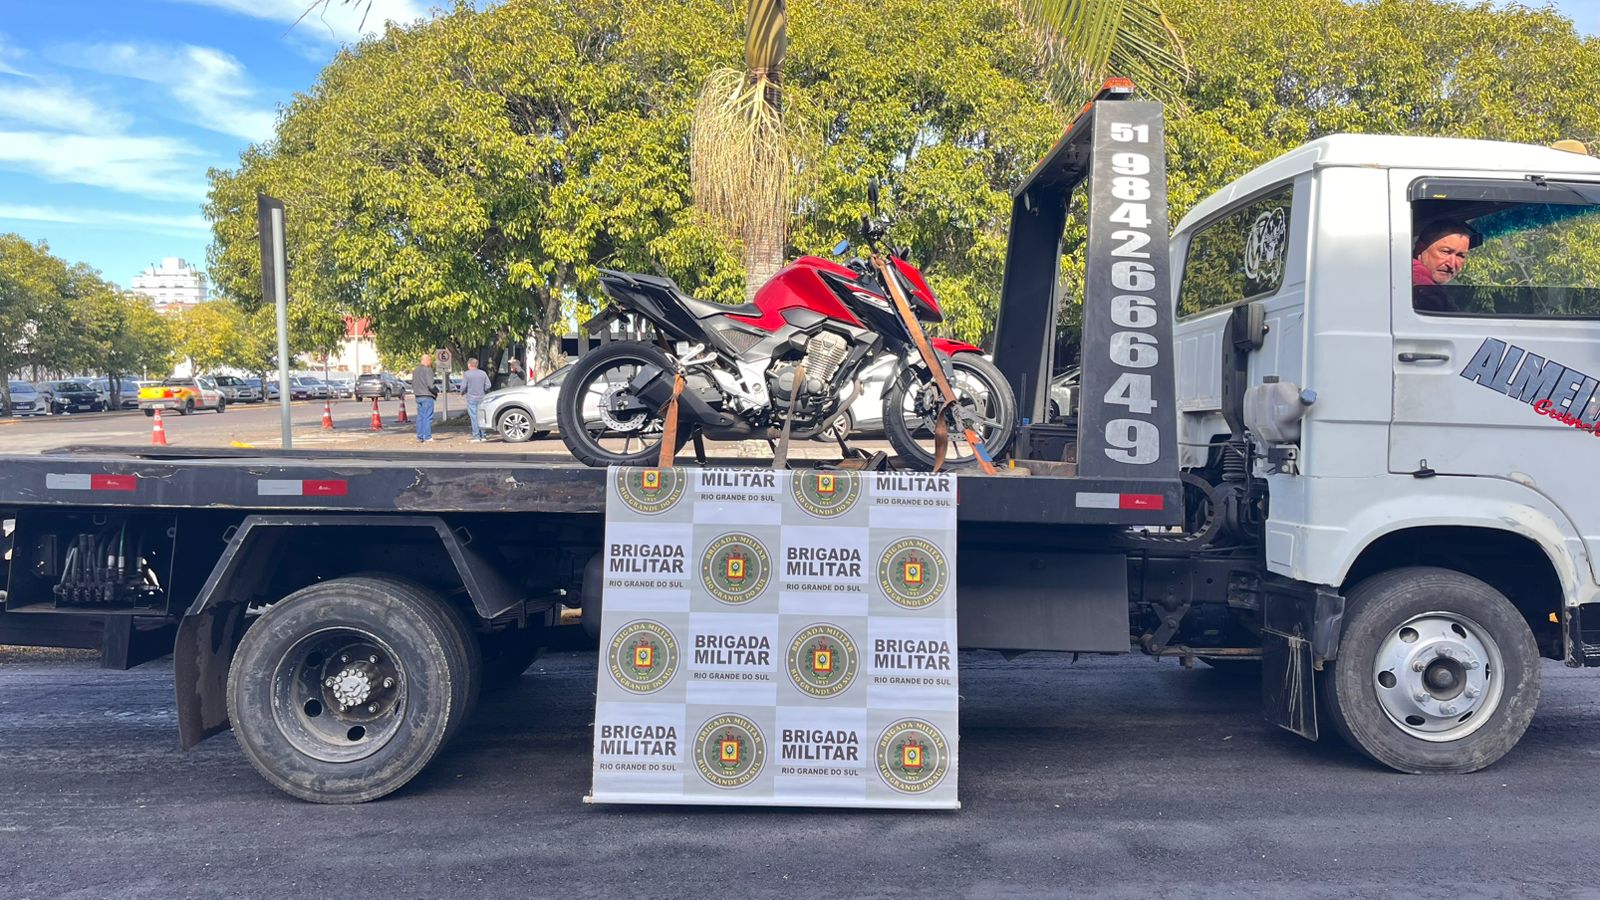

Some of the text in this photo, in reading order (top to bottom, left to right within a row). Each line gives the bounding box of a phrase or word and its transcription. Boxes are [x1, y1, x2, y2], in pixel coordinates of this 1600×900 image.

[1110, 122, 1149, 143] 51
[702, 473, 775, 487] MILITAR
[877, 477, 950, 492] MILITAR
[611, 544, 684, 558] BRIGADA
[706, 536, 766, 560] BRIGADA MILITAR
[788, 547, 862, 561] BRIGADA
[882, 540, 944, 566] BRIGADA MILITAR
[610, 558, 684, 573] MILITAR
[786, 562, 861, 577] MILITAR
[613, 624, 674, 648] BRIGADA MILITAR
[695, 635, 770, 649] BRIGADA
[792, 627, 854, 653] BRIGADA MILITAR
[875, 640, 950, 654] BRIGADA
[694, 650, 770, 665] MILITAR
[874, 654, 950, 670] MILITAR
[602, 726, 677, 739] BRIGADA
[698, 718, 760, 743] BRIGADA MILITAR
[782, 730, 858, 744] BRIGADA
[880, 722, 944, 748] BRIGADA MILITAR
[601, 740, 676, 756] MILITAR
[782, 744, 858, 760] MILITAR
